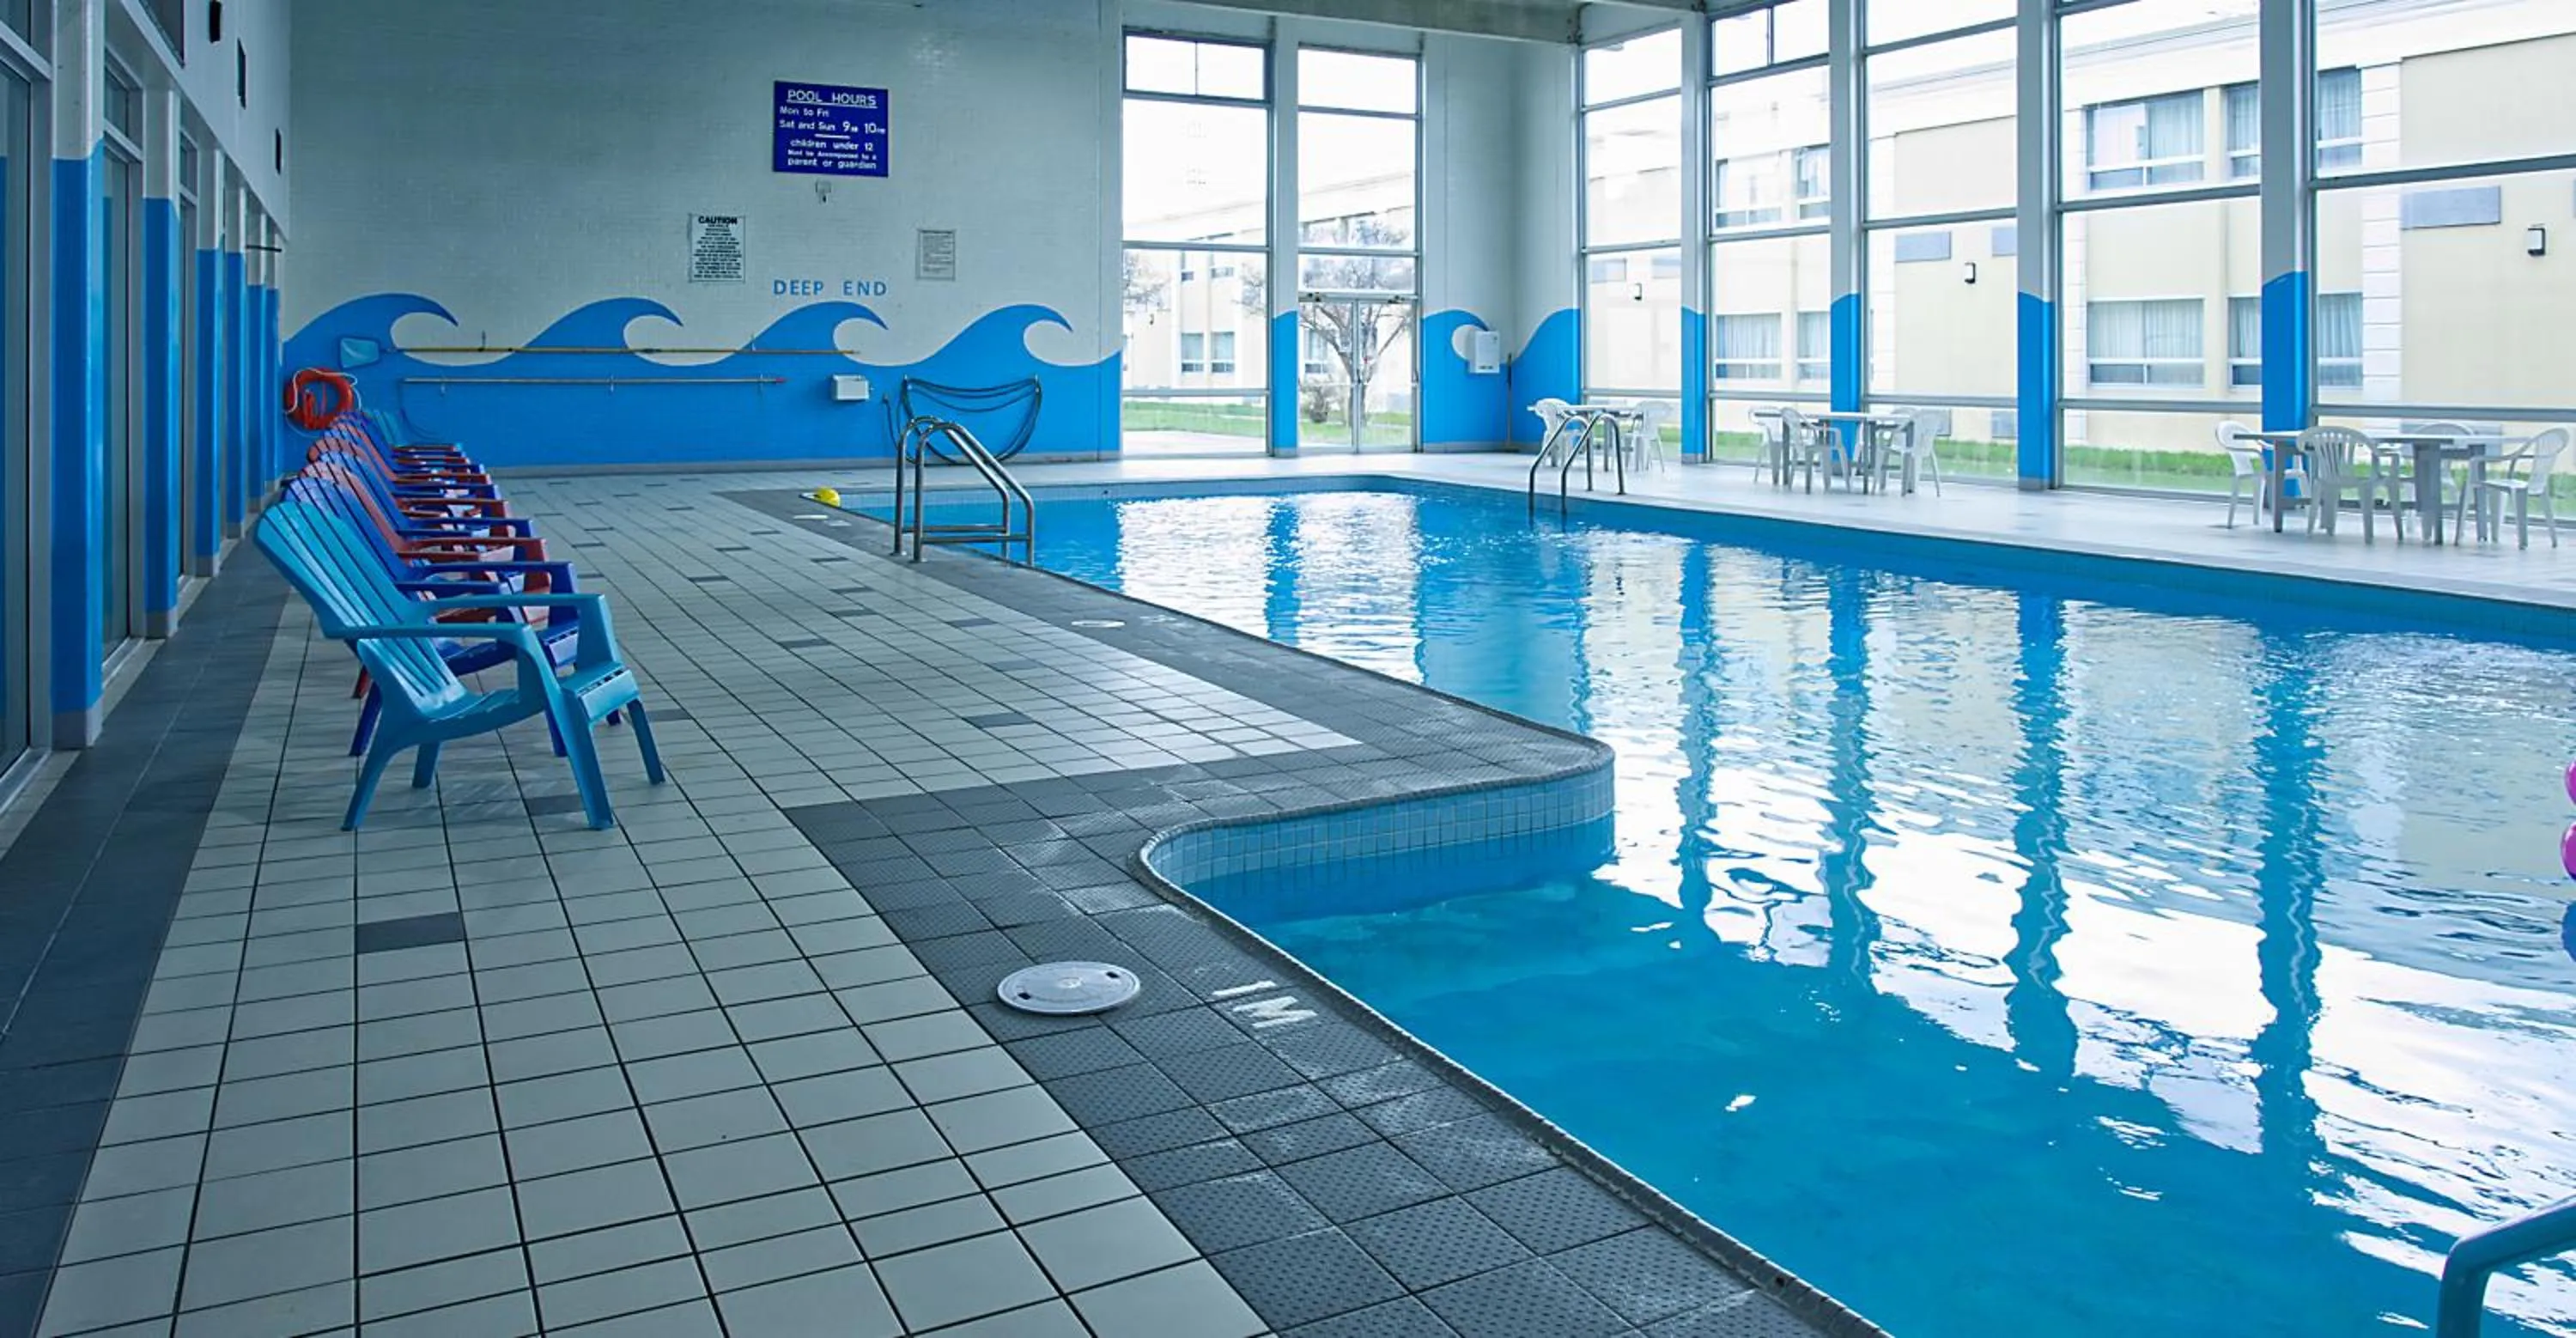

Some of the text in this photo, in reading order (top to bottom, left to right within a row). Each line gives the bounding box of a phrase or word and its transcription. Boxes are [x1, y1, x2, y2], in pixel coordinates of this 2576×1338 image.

[787, 89, 877, 106] POOL HOURS
[780, 106, 829, 117] Mon to Fri
[780, 119, 794, 128] Sat
[818, 122, 835, 131] Sun
[790, 138, 874, 151] children under 12
[787, 158, 817, 167] parent
[838, 160, 877, 170] guardian
[698, 216, 738, 225] CAUTION
[774, 279, 887, 296] DEEP END
